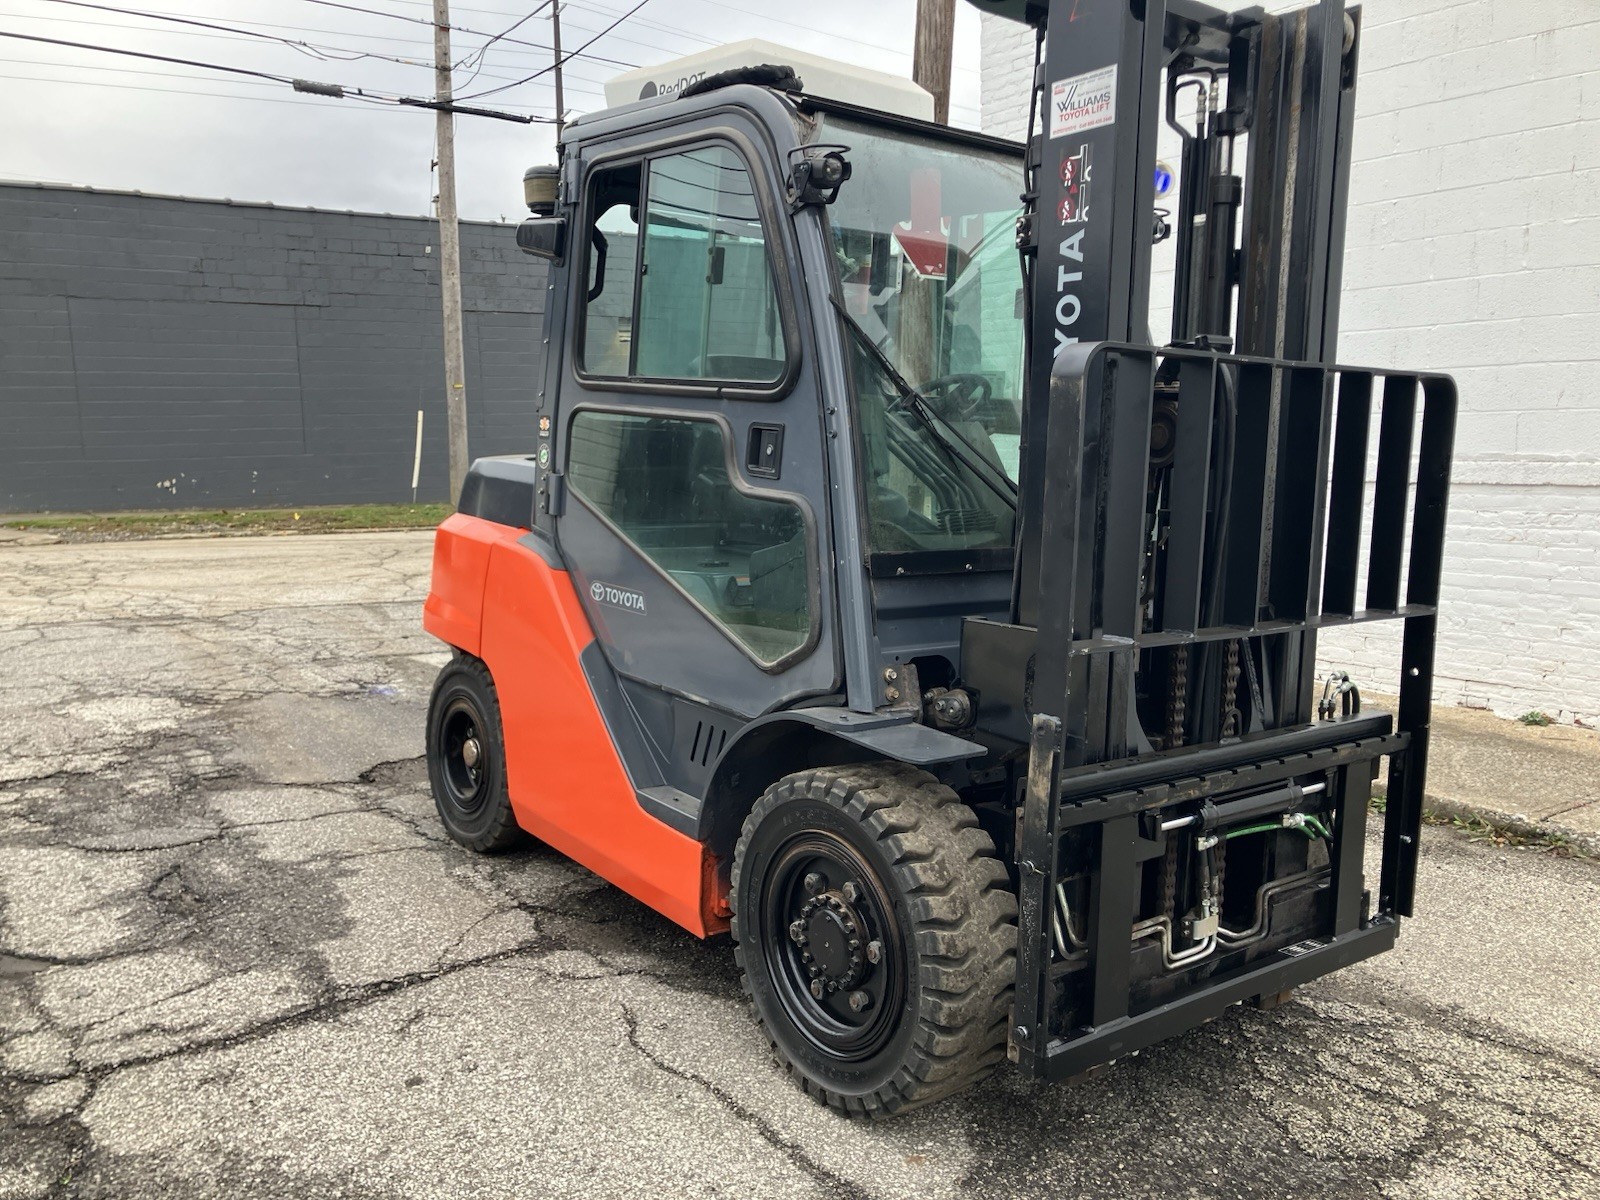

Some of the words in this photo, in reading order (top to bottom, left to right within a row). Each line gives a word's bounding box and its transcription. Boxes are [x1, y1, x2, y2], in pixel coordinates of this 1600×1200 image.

[1057, 84, 1111, 113] WILLIAMS
[1059, 108, 1090, 122] TOYOTA
[1091, 102, 1110, 114] LIFT
[1053, 228, 1085, 358] YOTA
[605, 587, 645, 611] TOYOTA
